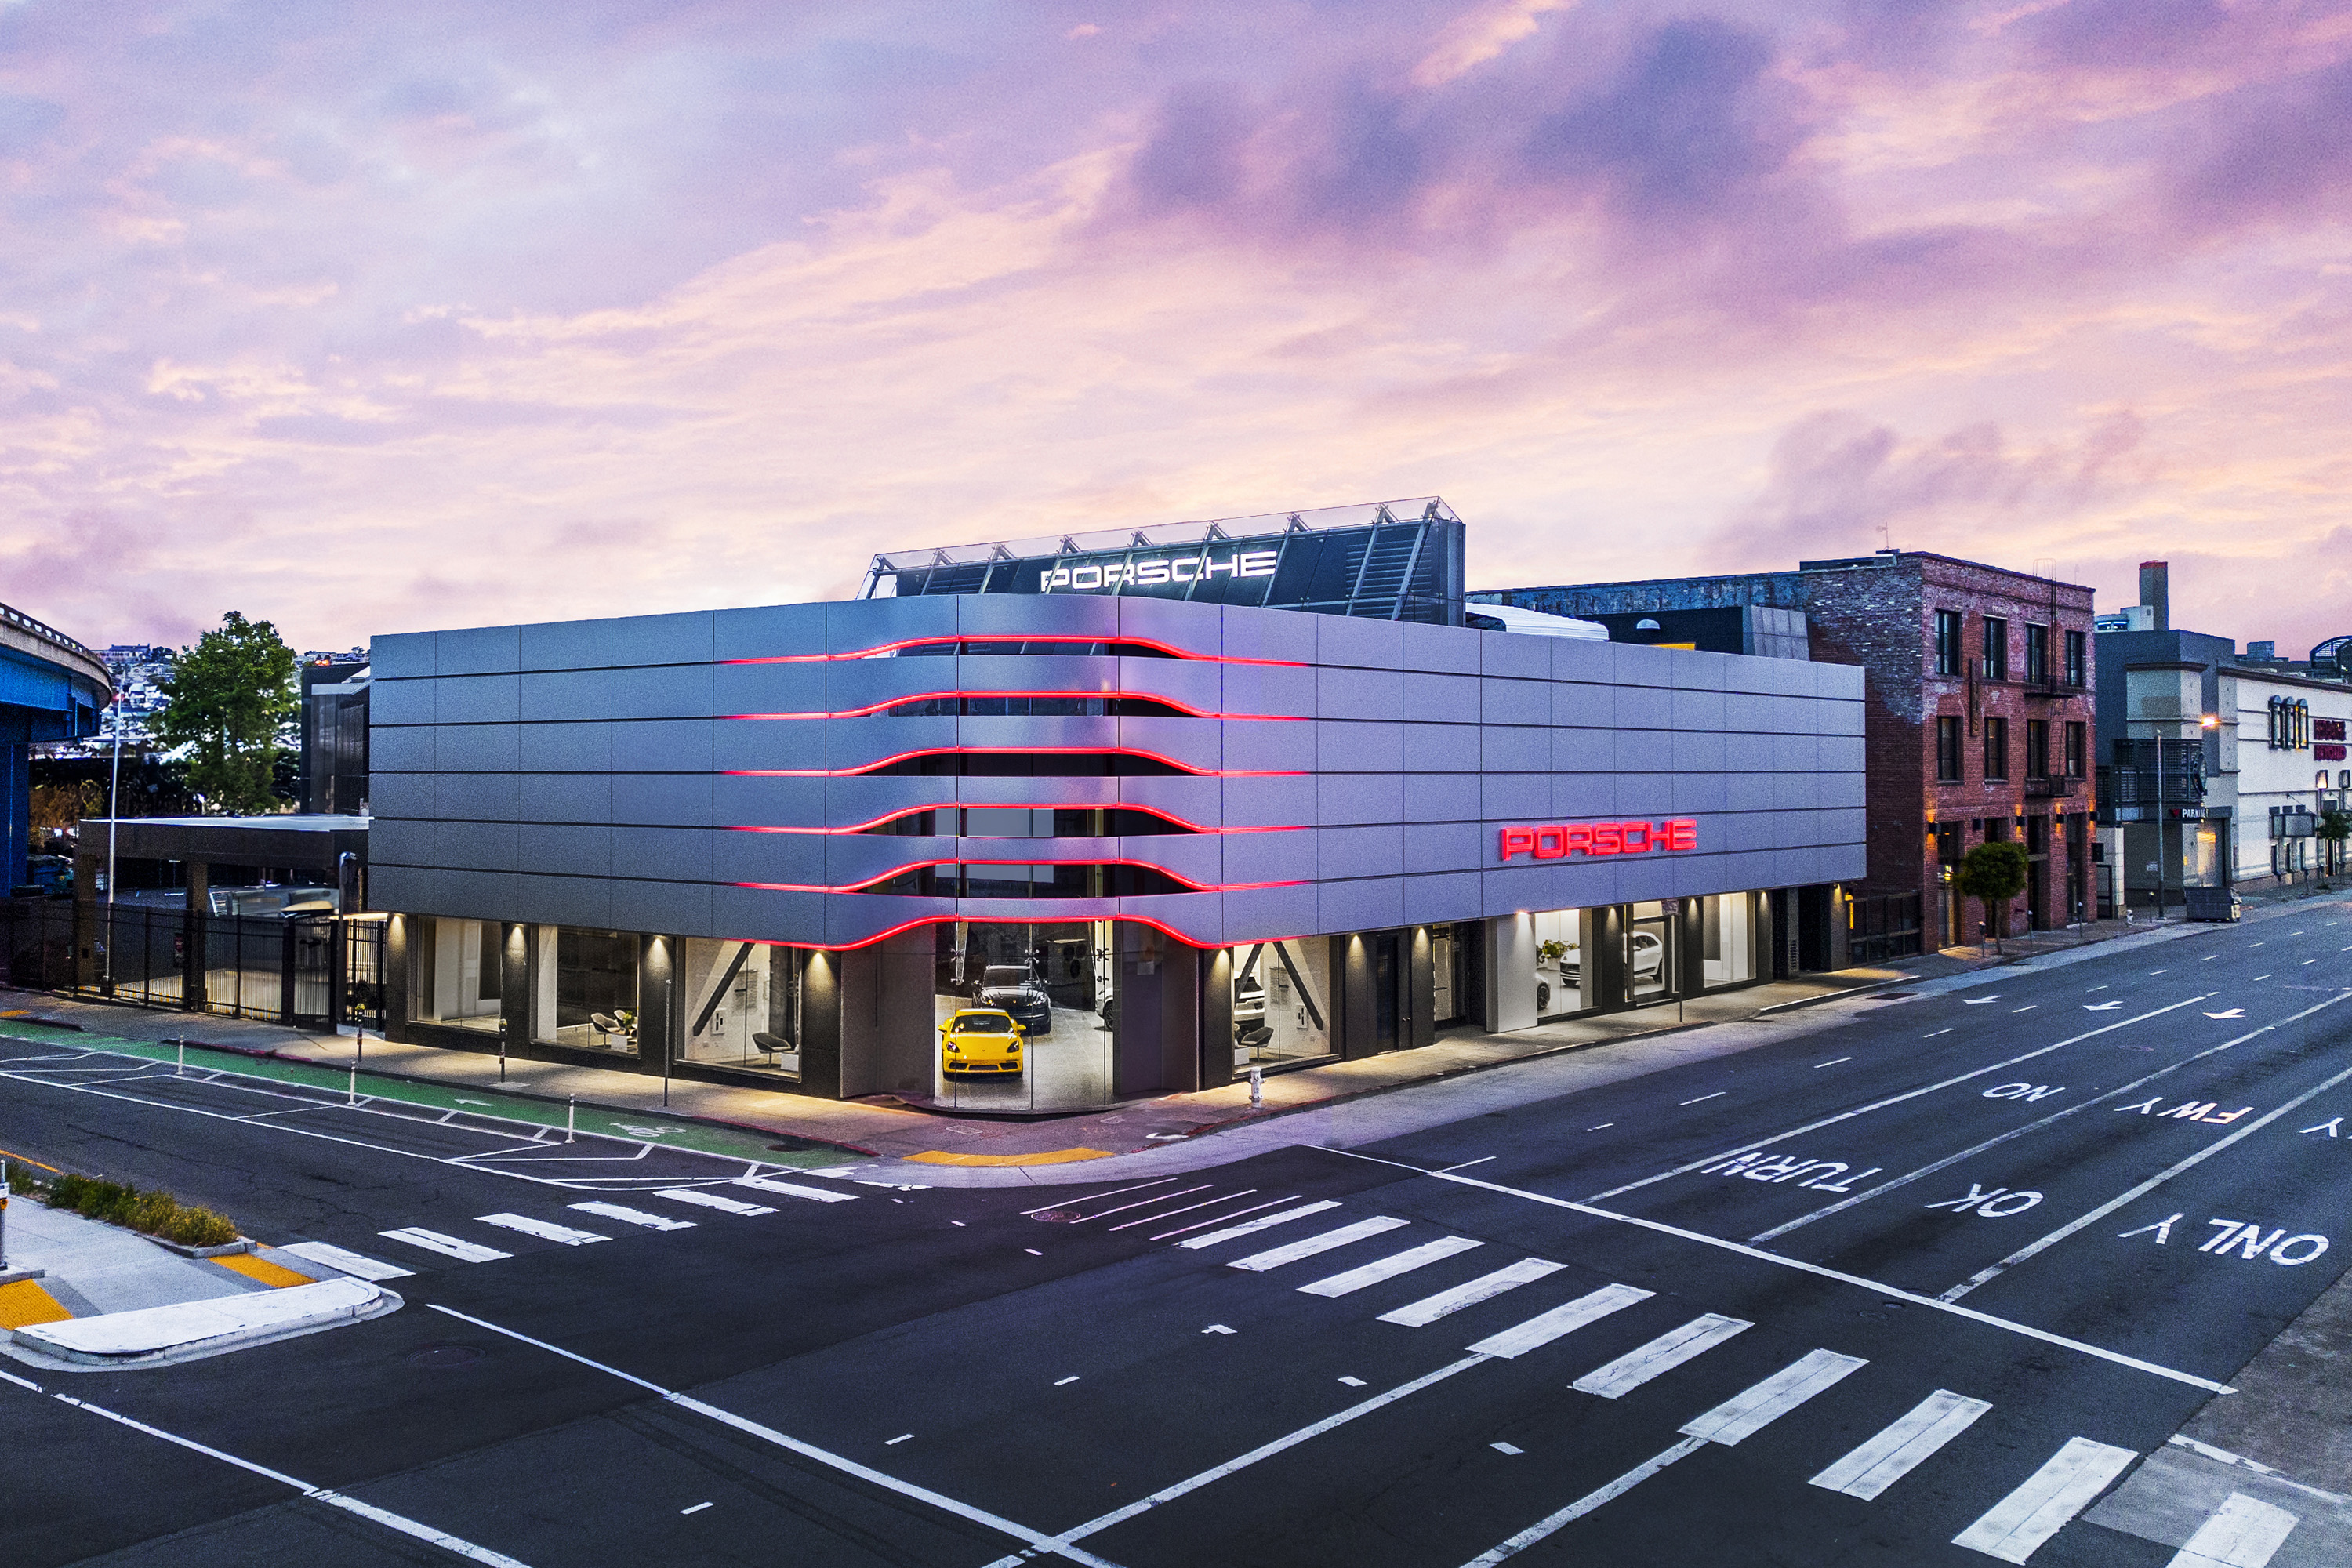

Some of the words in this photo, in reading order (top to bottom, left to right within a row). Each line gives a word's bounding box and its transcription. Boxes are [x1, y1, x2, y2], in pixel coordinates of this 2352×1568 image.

[1041, 550, 1277, 592] PORSCHE
[1501, 819, 1697, 861] PORSCHE
[1982, 1083, 2066, 1102] NO
[2114, 1097, 2254, 1124] FWY
[1700, 1152, 1882, 1192] TURN
[1926, 1183, 2044, 1218] OK
